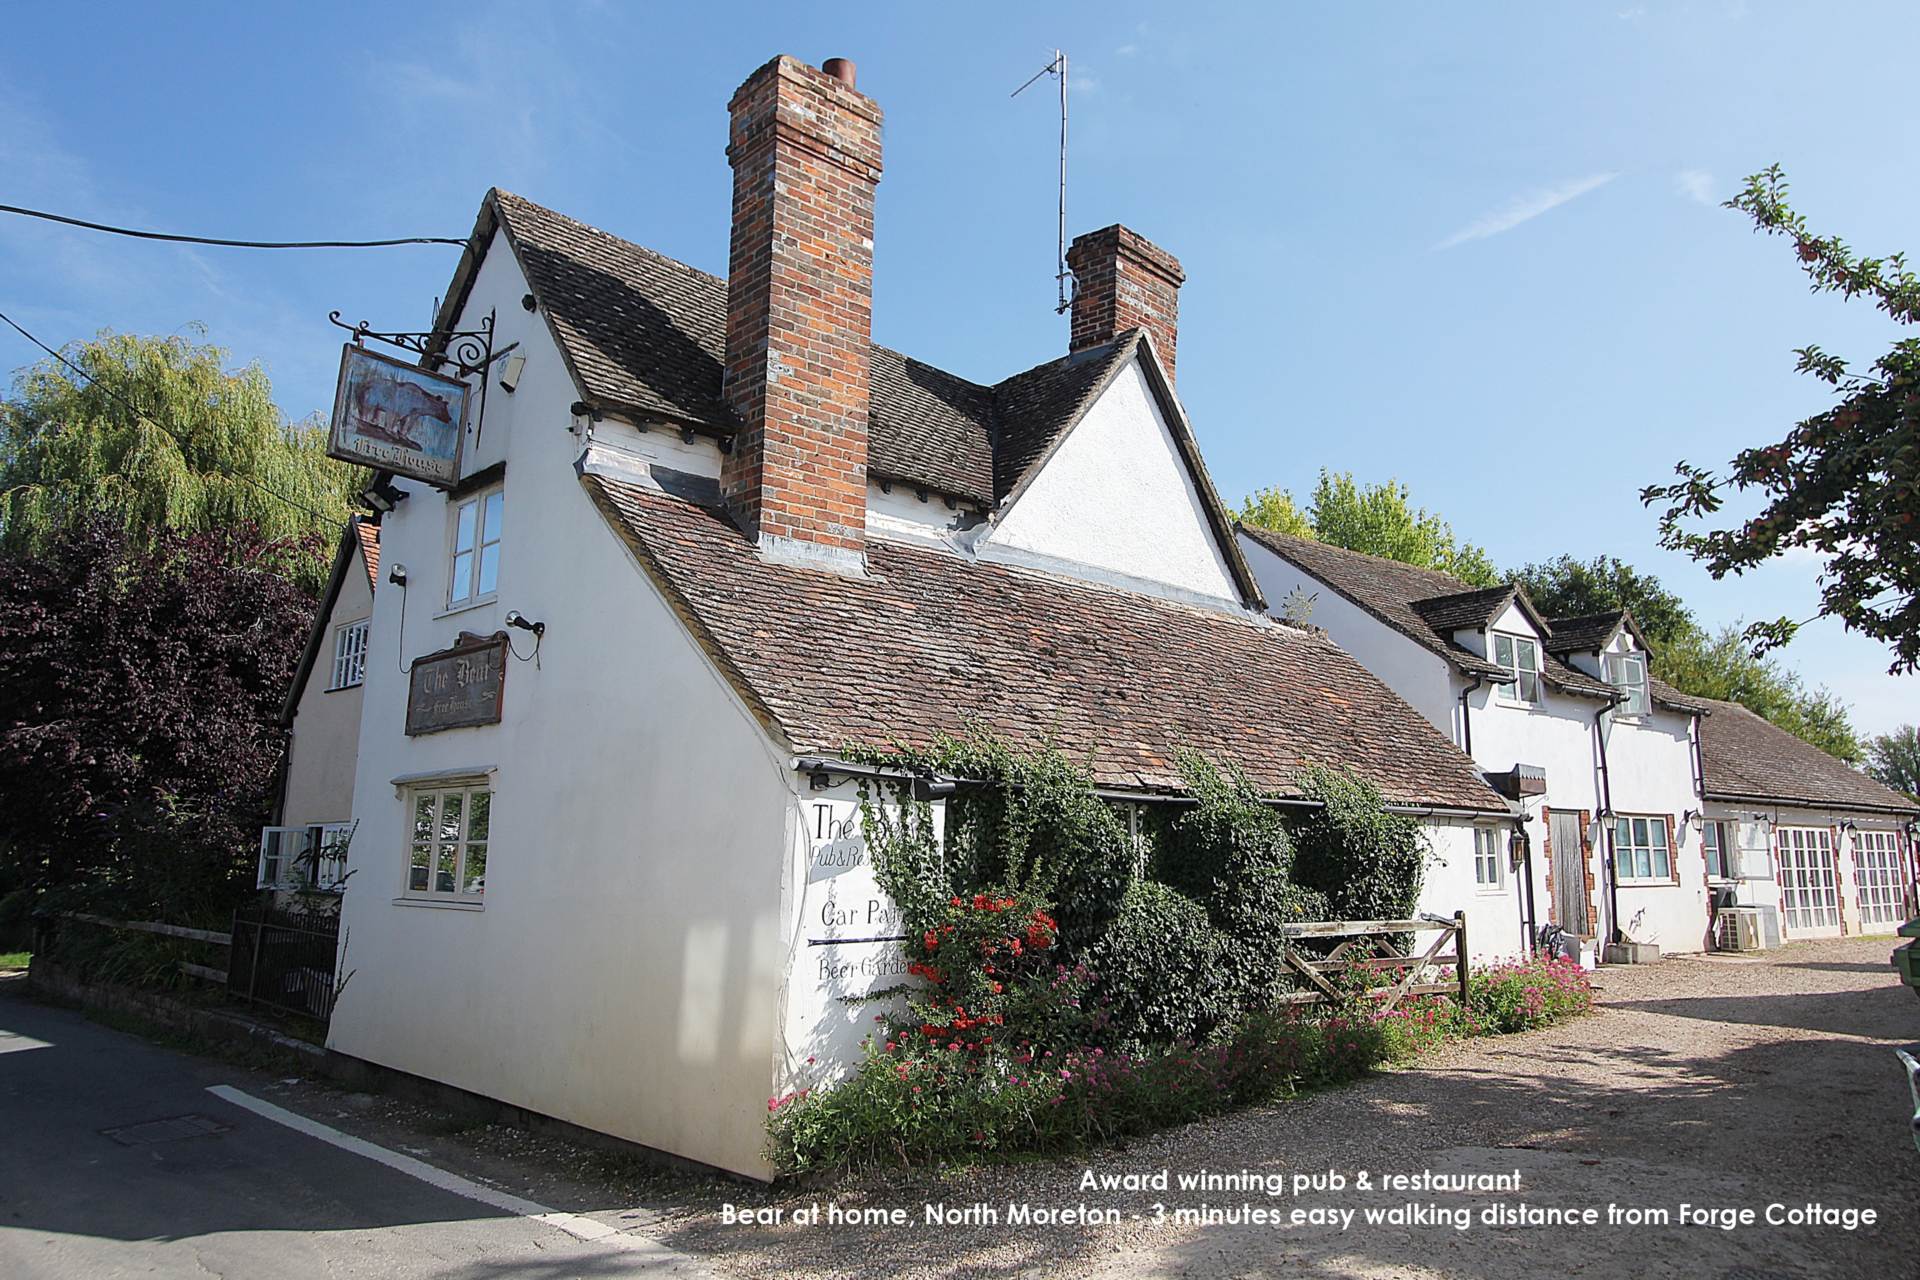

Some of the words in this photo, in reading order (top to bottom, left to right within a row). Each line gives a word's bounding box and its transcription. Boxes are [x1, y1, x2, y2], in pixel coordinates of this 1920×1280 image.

[353, 438, 390, 459] Free
[423, 666, 449, 694] The
[456, 659, 489, 688] Bear
[812, 803, 855, 840] The
[821, 900, 858, 926] Car
[819, 958, 858, 981] Beer
